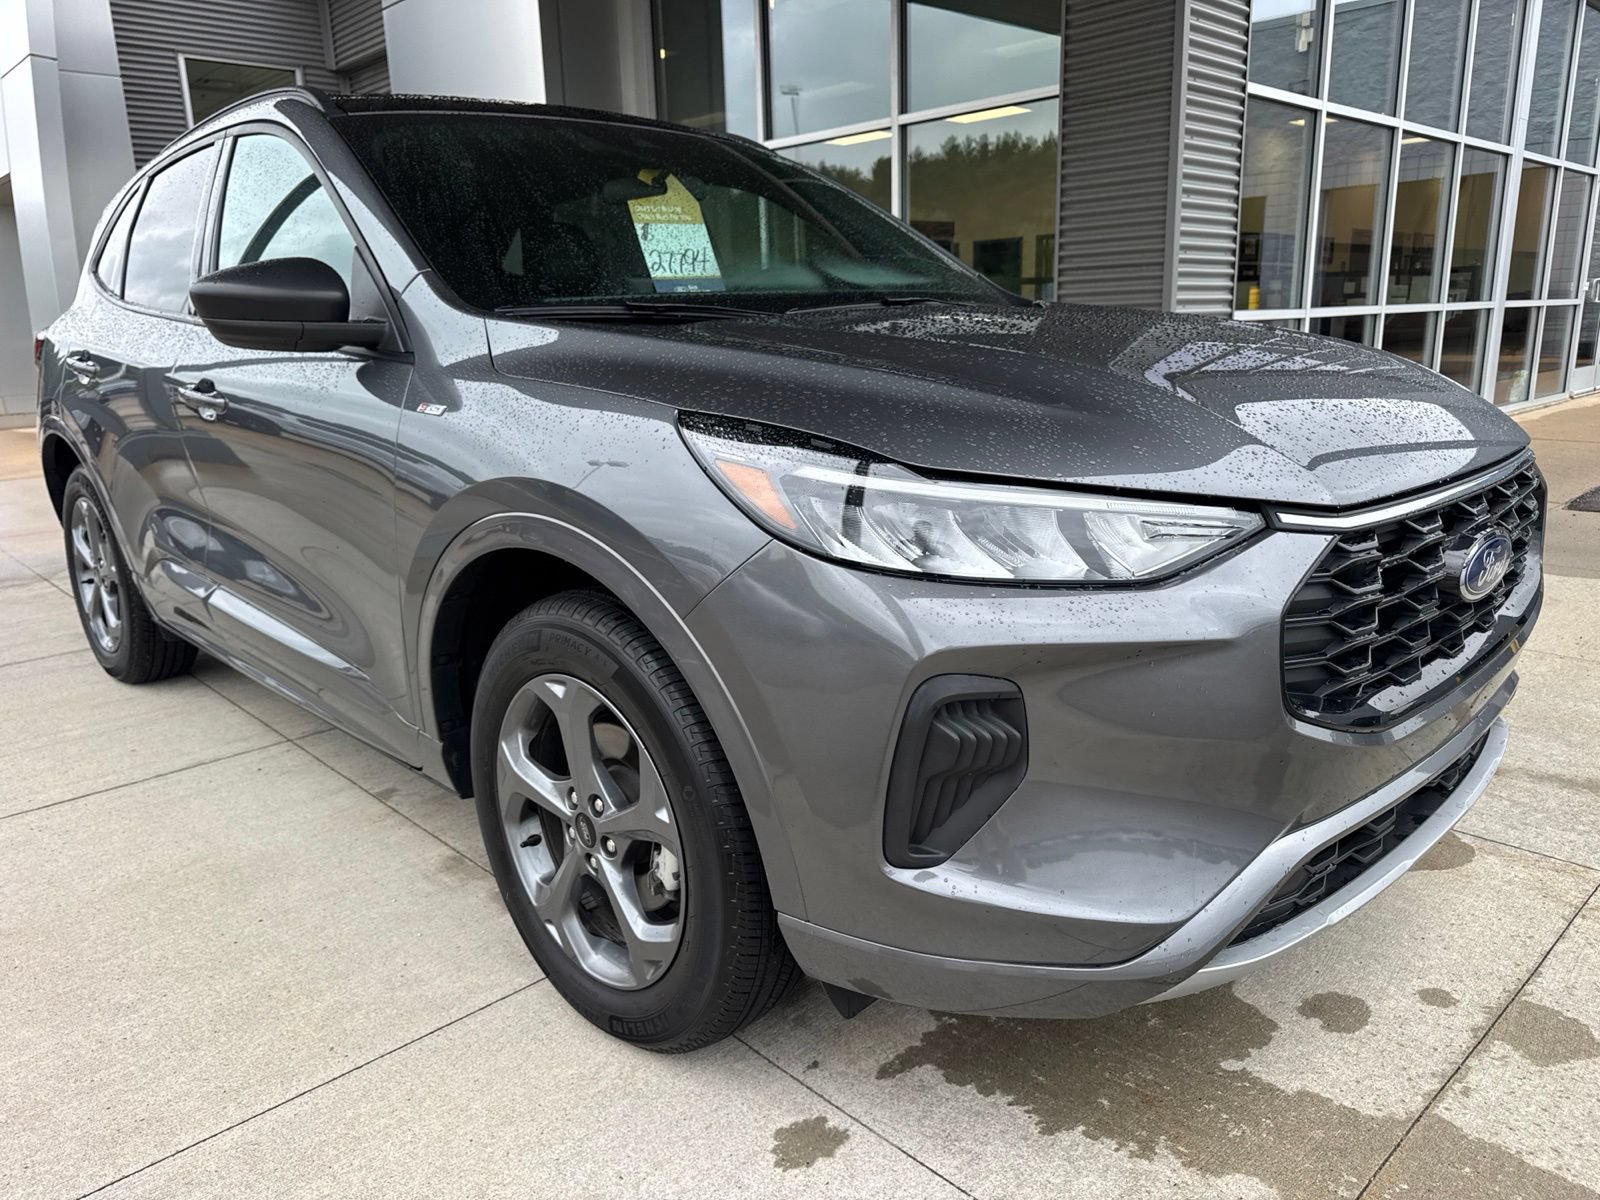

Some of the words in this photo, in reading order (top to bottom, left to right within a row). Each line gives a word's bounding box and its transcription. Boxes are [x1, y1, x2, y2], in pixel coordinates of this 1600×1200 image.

[1478, 545, 1507, 587] Ford
[549, 633, 592, 656] PRIMACY
[611, 1009, 674, 1036] ICHELIN
